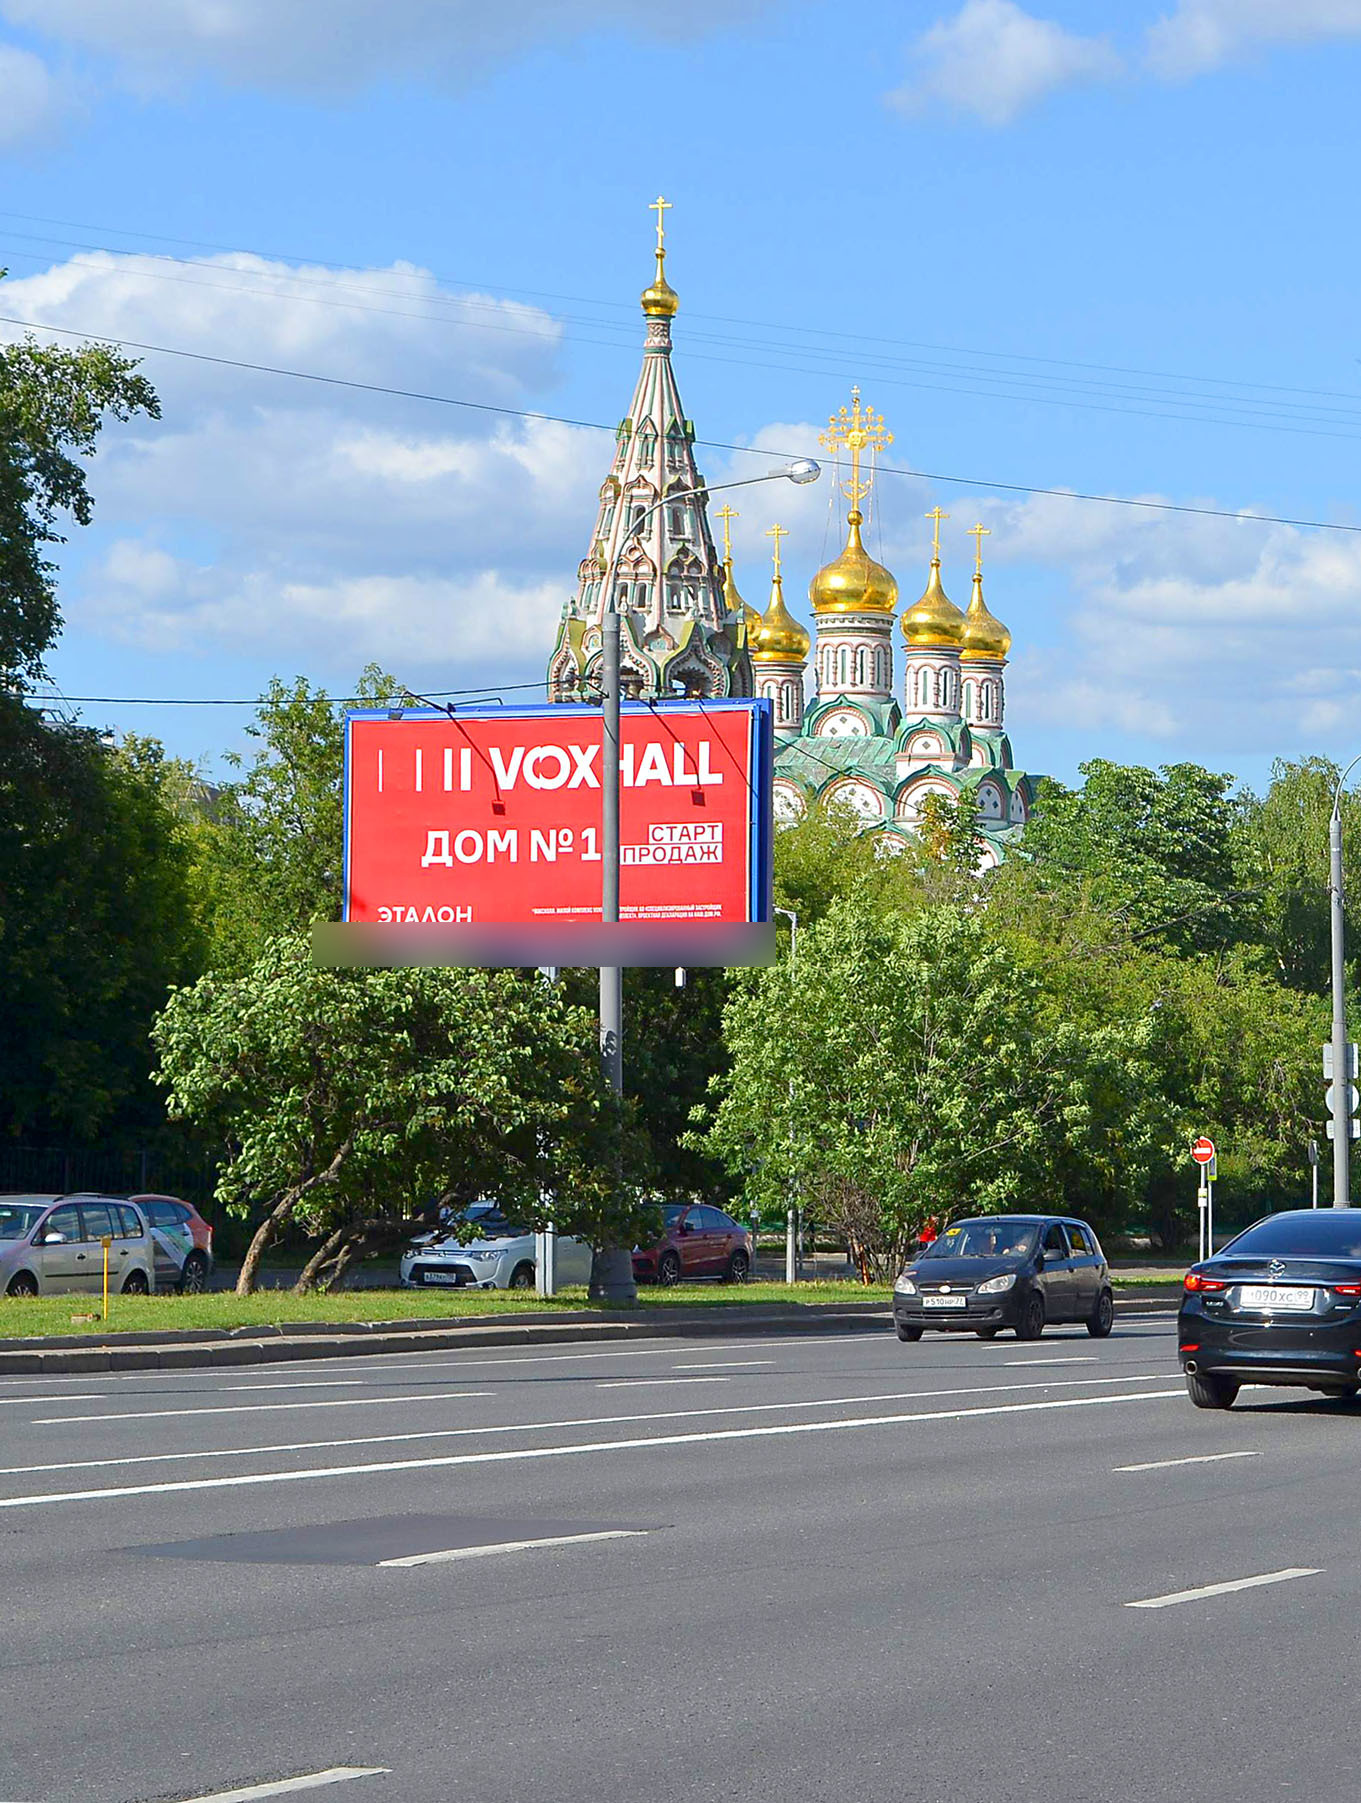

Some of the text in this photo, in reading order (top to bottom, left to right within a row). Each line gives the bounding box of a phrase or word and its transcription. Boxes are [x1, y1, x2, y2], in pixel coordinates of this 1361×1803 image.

[651, 825, 719, 842] СТАРТ
[421, 829, 518, 868] ДОМ
[623, 845, 719, 864] ПРОДАЖ
[377, 905, 473, 923] ЭТАЛОН
